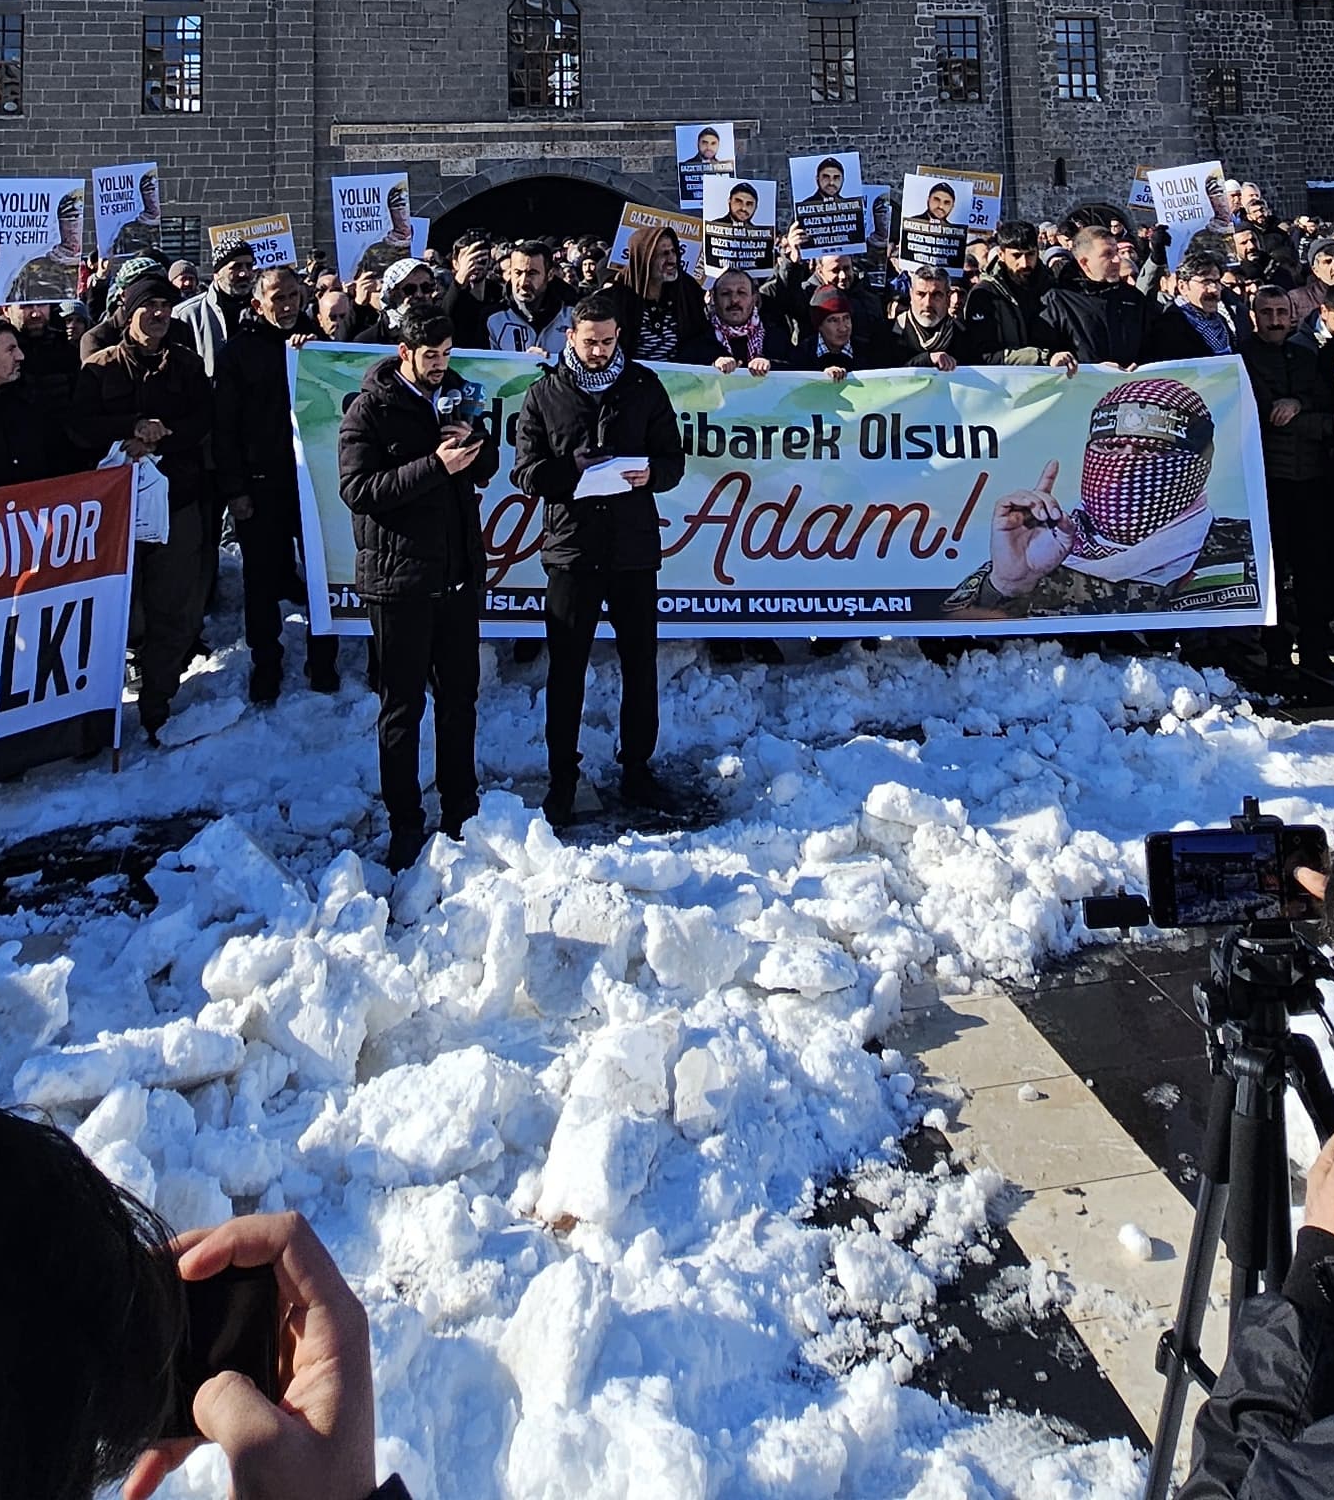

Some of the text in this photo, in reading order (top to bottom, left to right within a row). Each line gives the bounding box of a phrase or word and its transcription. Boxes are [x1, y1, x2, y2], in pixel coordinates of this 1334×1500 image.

[98, 175, 134, 192] YOLUN
[1156, 176, 1198, 197] YOLUN
[0, 193, 50, 212] YOLUN
[99, 190, 135, 203] YOLUMUZ
[339, 187, 380, 206] YOLUN
[1161, 194, 1201, 210] YOLUMUZ
[100, 205, 110, 215] EY
[341, 206, 381, 218] YOLUMUZ
[1165, 211, 1176, 223] EY
[0, 215, 48, 228] YOLUMUZ
[342, 219, 382, 234] EY ŞEHİT!
[0, 229, 48, 247] EY ŞEHİT!
[251, 238, 278, 252] ENİŞ
[858, 411, 999, 461] Olsun
[659, 471, 989, 586] Adam!
[485, 590, 912, 618] İSLA OPLUM KURULUŞLARI
